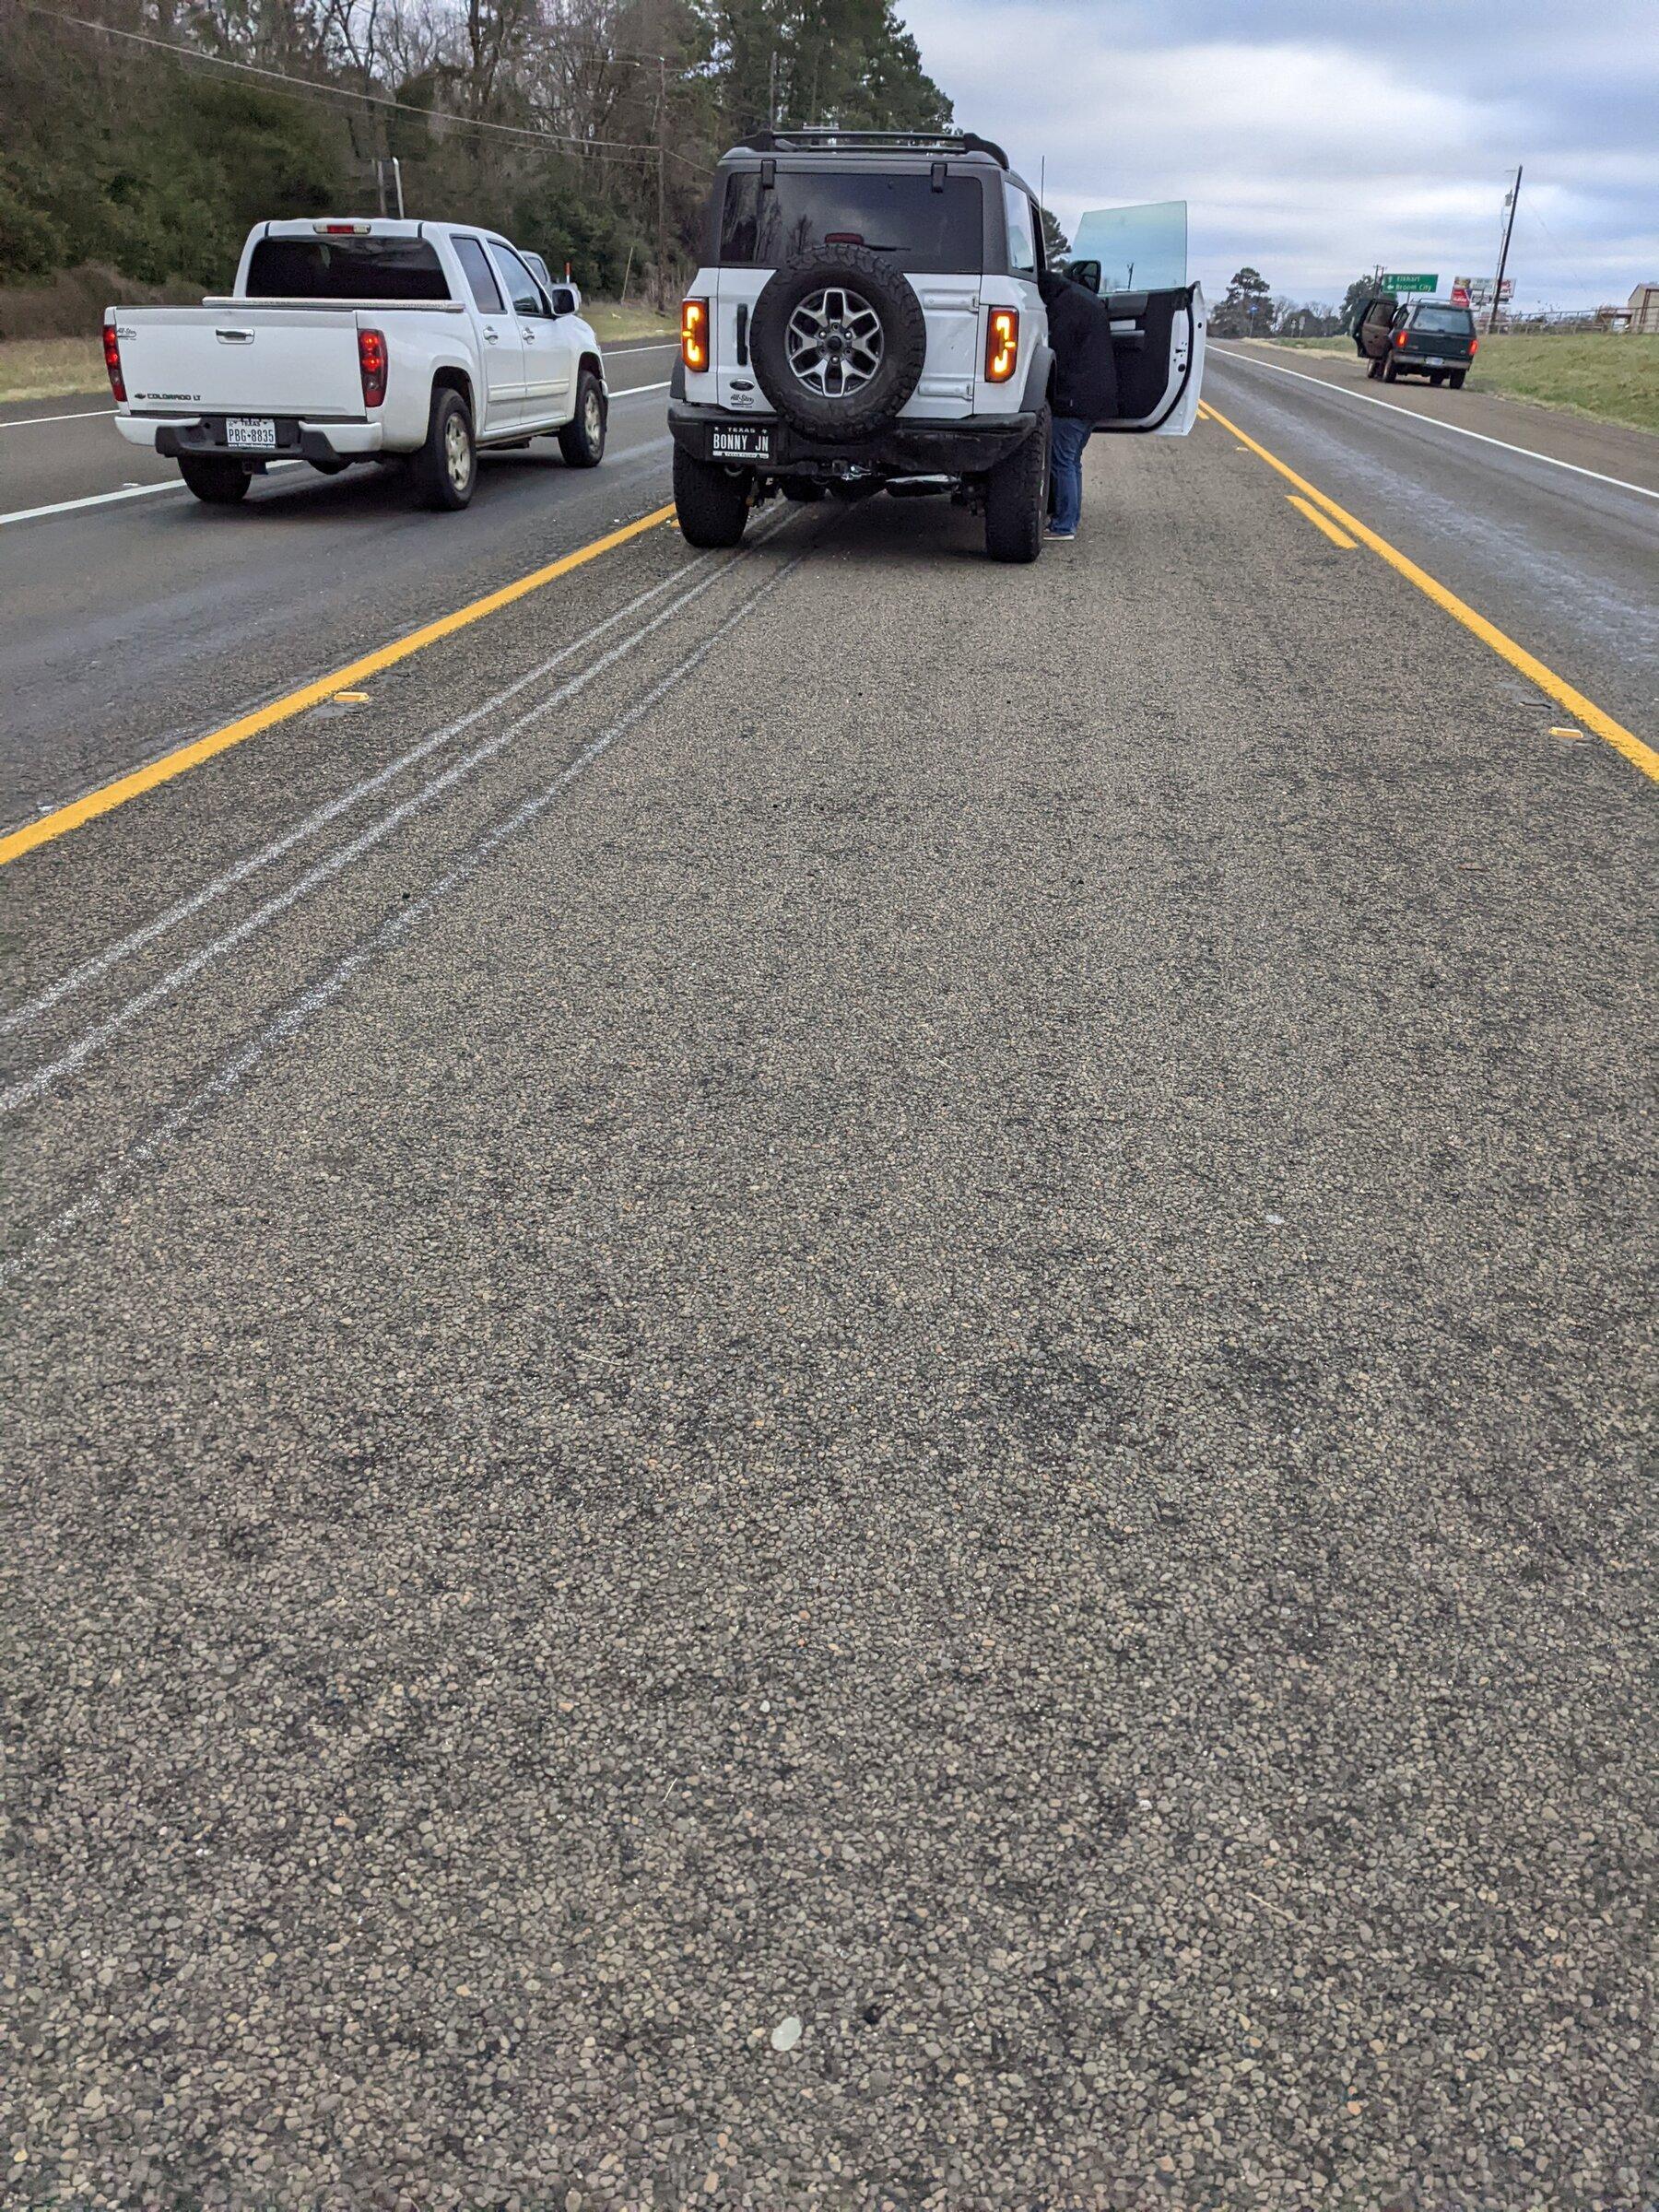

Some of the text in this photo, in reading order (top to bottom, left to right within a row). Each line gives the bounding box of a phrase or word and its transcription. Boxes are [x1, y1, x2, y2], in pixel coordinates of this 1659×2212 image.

[1418, 284, 1431, 292] City
[712, 433, 769, 452] BONNY JN
